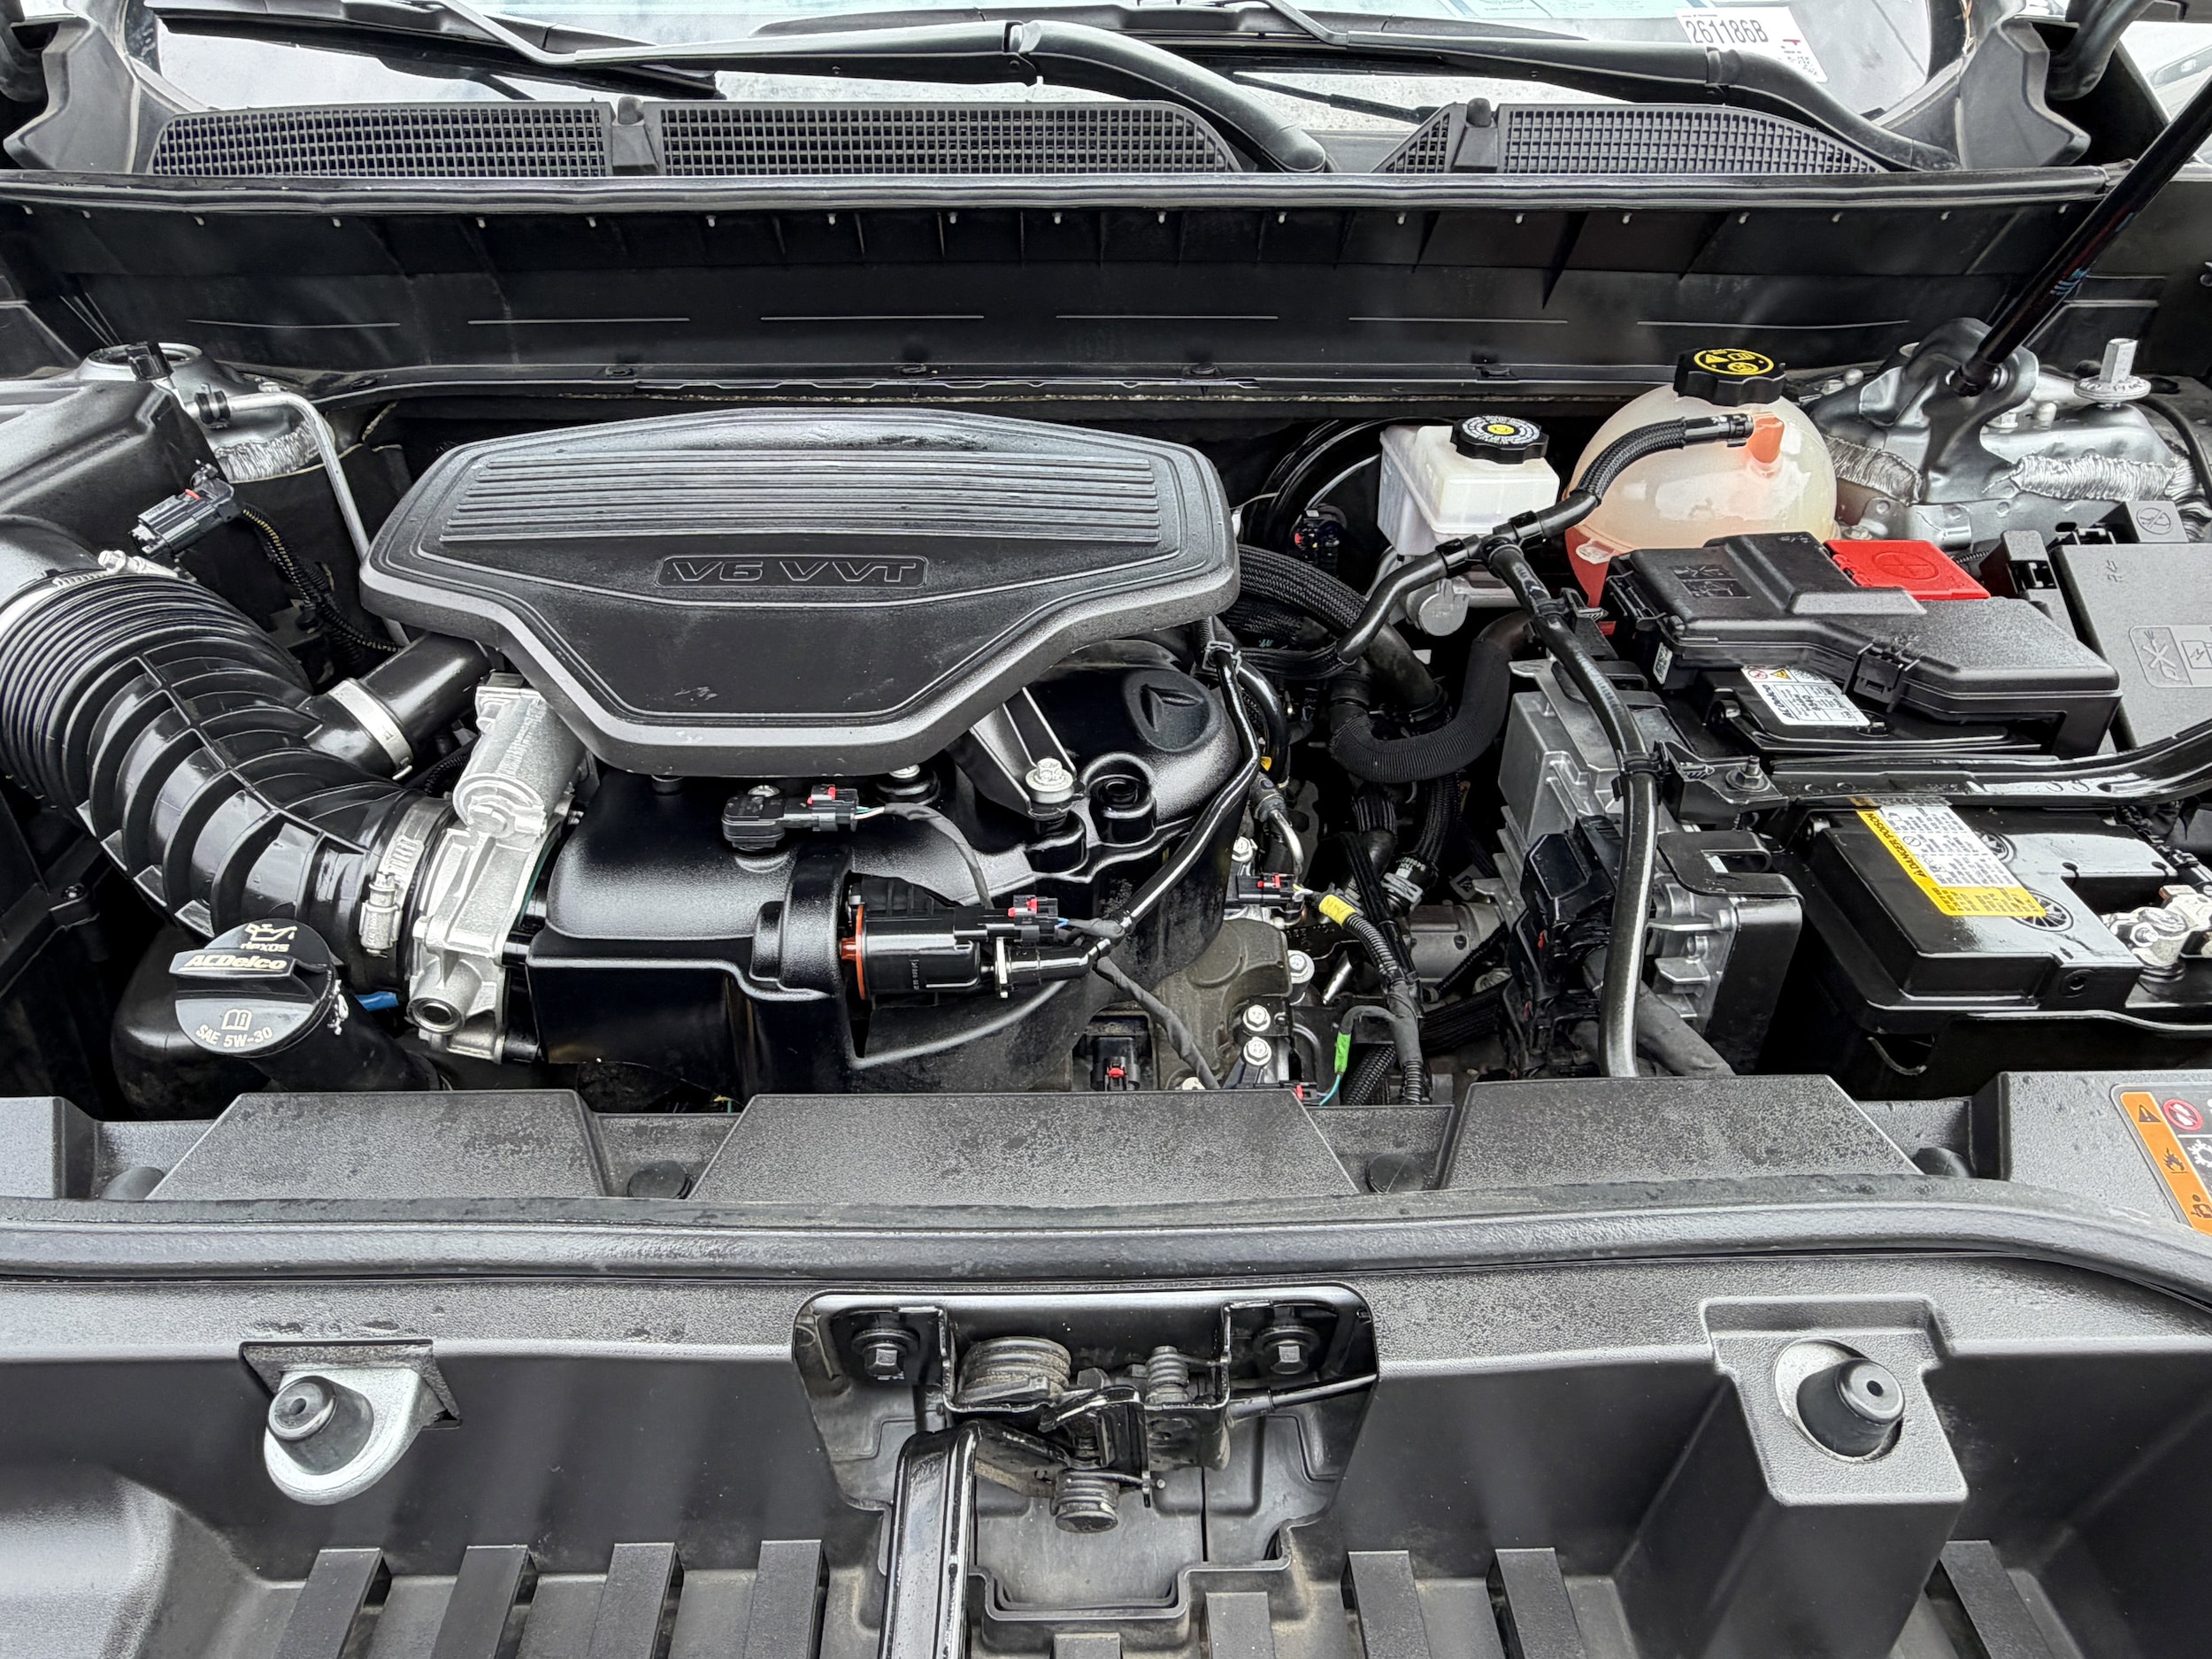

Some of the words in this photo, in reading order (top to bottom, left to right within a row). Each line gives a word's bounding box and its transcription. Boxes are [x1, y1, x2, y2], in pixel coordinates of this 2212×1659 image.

[1686, 19, 1769, 43] 261186B
[672, 561, 764, 582] V6
[780, 561, 917, 583] VVT
[1865, 813, 1893, 839] POISON
[1889, 839, 1919, 869] DANGER
[185, 955, 288, 970] ACDelco
[196, 1024, 221, 1045] SAE
[223, 1026, 273, 1048] 5W-30
